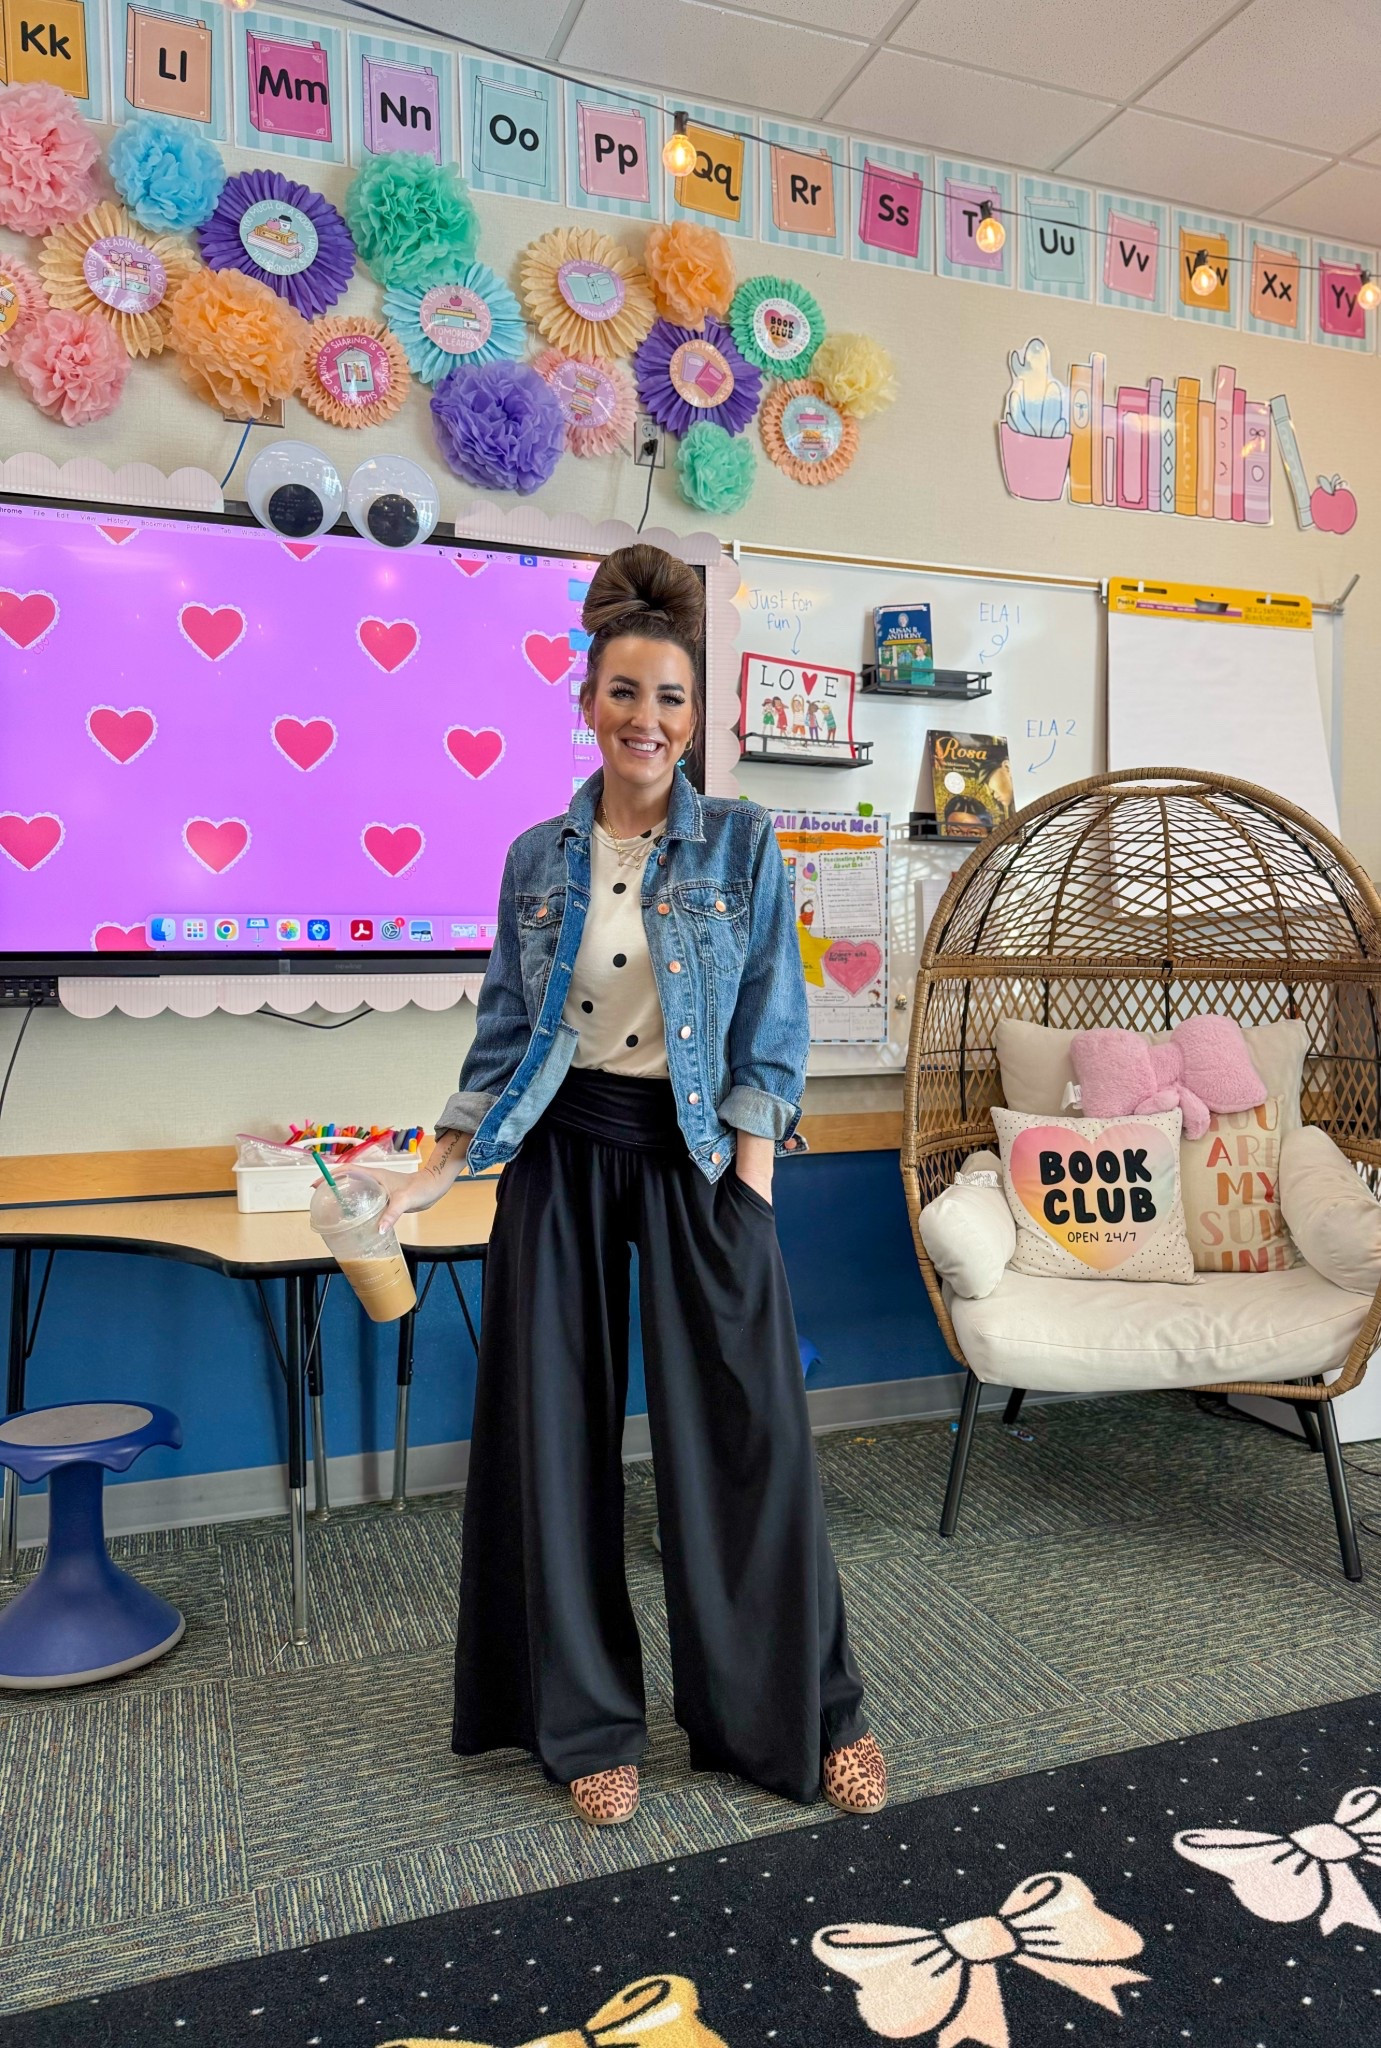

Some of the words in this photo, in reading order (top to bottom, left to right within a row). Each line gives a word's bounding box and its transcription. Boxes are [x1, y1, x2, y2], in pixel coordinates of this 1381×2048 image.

[21, 21, 71, 59] Kk
[159, 48, 187, 82] Ll
[258, 65, 327, 105] Mm
[380, 92, 432, 131] Nn
[489, 115, 539, 151] Oo
[594, 133, 638, 174] Pp
[692, 151, 739, 201] Qq
[790, 175, 821, 205] Rr
[878, 194, 909, 226] Ss
[242, 216, 254, 229] TOO
[250, 202, 274, 218] MUCH
[275, 202, 286, 210] OF
[295, 213, 313, 232] GOOD
[305, 235, 316, 259] THING
[1040, 228, 1074, 255] Uu
[100, 238, 144, 254] READING
[145, 252, 156, 262] IS
[154, 273, 165, 297] GIFT
[1120, 240, 1150, 272] Vv
[87, 252, 106, 296] READING
[1262, 271, 1292, 301] Xx
[427, 287, 447, 303] TODAY
[459, 288, 486, 311] READER
[1332, 284, 1357, 317] Yy
[770, 316, 795, 330] BOOK
[770, 325, 794, 340] CLUB
[438, 336, 443, 345] A
[446, 338, 475, 349] LEADER
[330, 337, 367, 349] SHARING
[368, 342, 378, 351] IS
[376, 351, 389, 383] CARING
[0, 507, 23, 515] hrome
[80, 514, 97, 522] View
[107, 516, 131, 526] History
[141, 520, 177, 529] Bookmarks
[220, 527, 232, 535] Tab
[748, 589, 788, 610] Just
[980, 602, 1009, 623] ELA
[767, 613, 790, 631] fun
[887, 632, 922, 641] ANTHONY
[888, 626, 912, 635] SUSAN
[1027, 719, 1058, 738] ELA
[1065, 719, 1077, 737] 2
[934, 736, 987, 762] Rosa
[774, 815, 797, 829] All
[799, 816, 847, 832] About
[849, 818, 879, 834] Me!
[1039, 1148, 1152, 1185] BOOK
[1206, 1135, 1280, 1168] ARE
[1217, 1172, 1279, 1206] MY
[1043, 1186, 1157, 1225] CLUB
[1067, 1231, 1099, 1243] OPEN
[1104, 1231, 1137, 1243] 24/7
[1200, 1209, 1285, 1247] SUN
